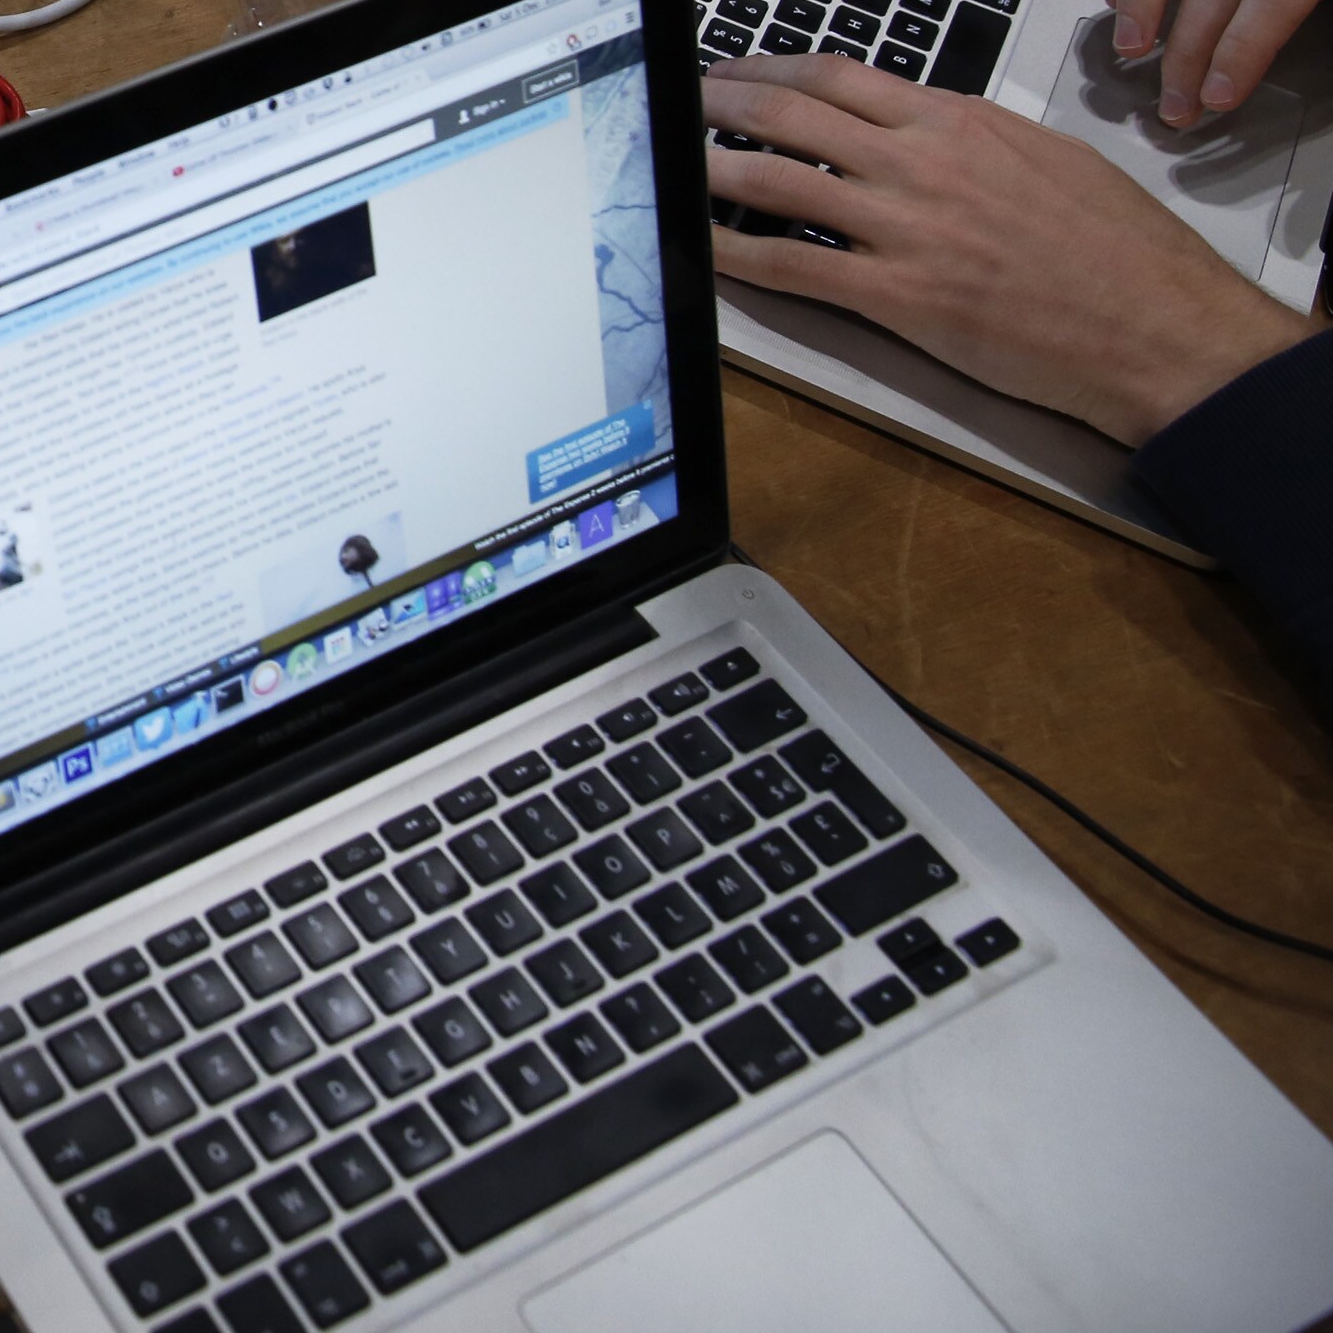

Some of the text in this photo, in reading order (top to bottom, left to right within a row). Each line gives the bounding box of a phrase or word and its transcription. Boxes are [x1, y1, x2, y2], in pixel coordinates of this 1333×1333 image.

[793, 7, 807, 16] Y
[847, 19, 862, 30] H
[906, 24, 921, 34] N
[779, 37, 792, 46] T
[893, 55, 907, 65] B
